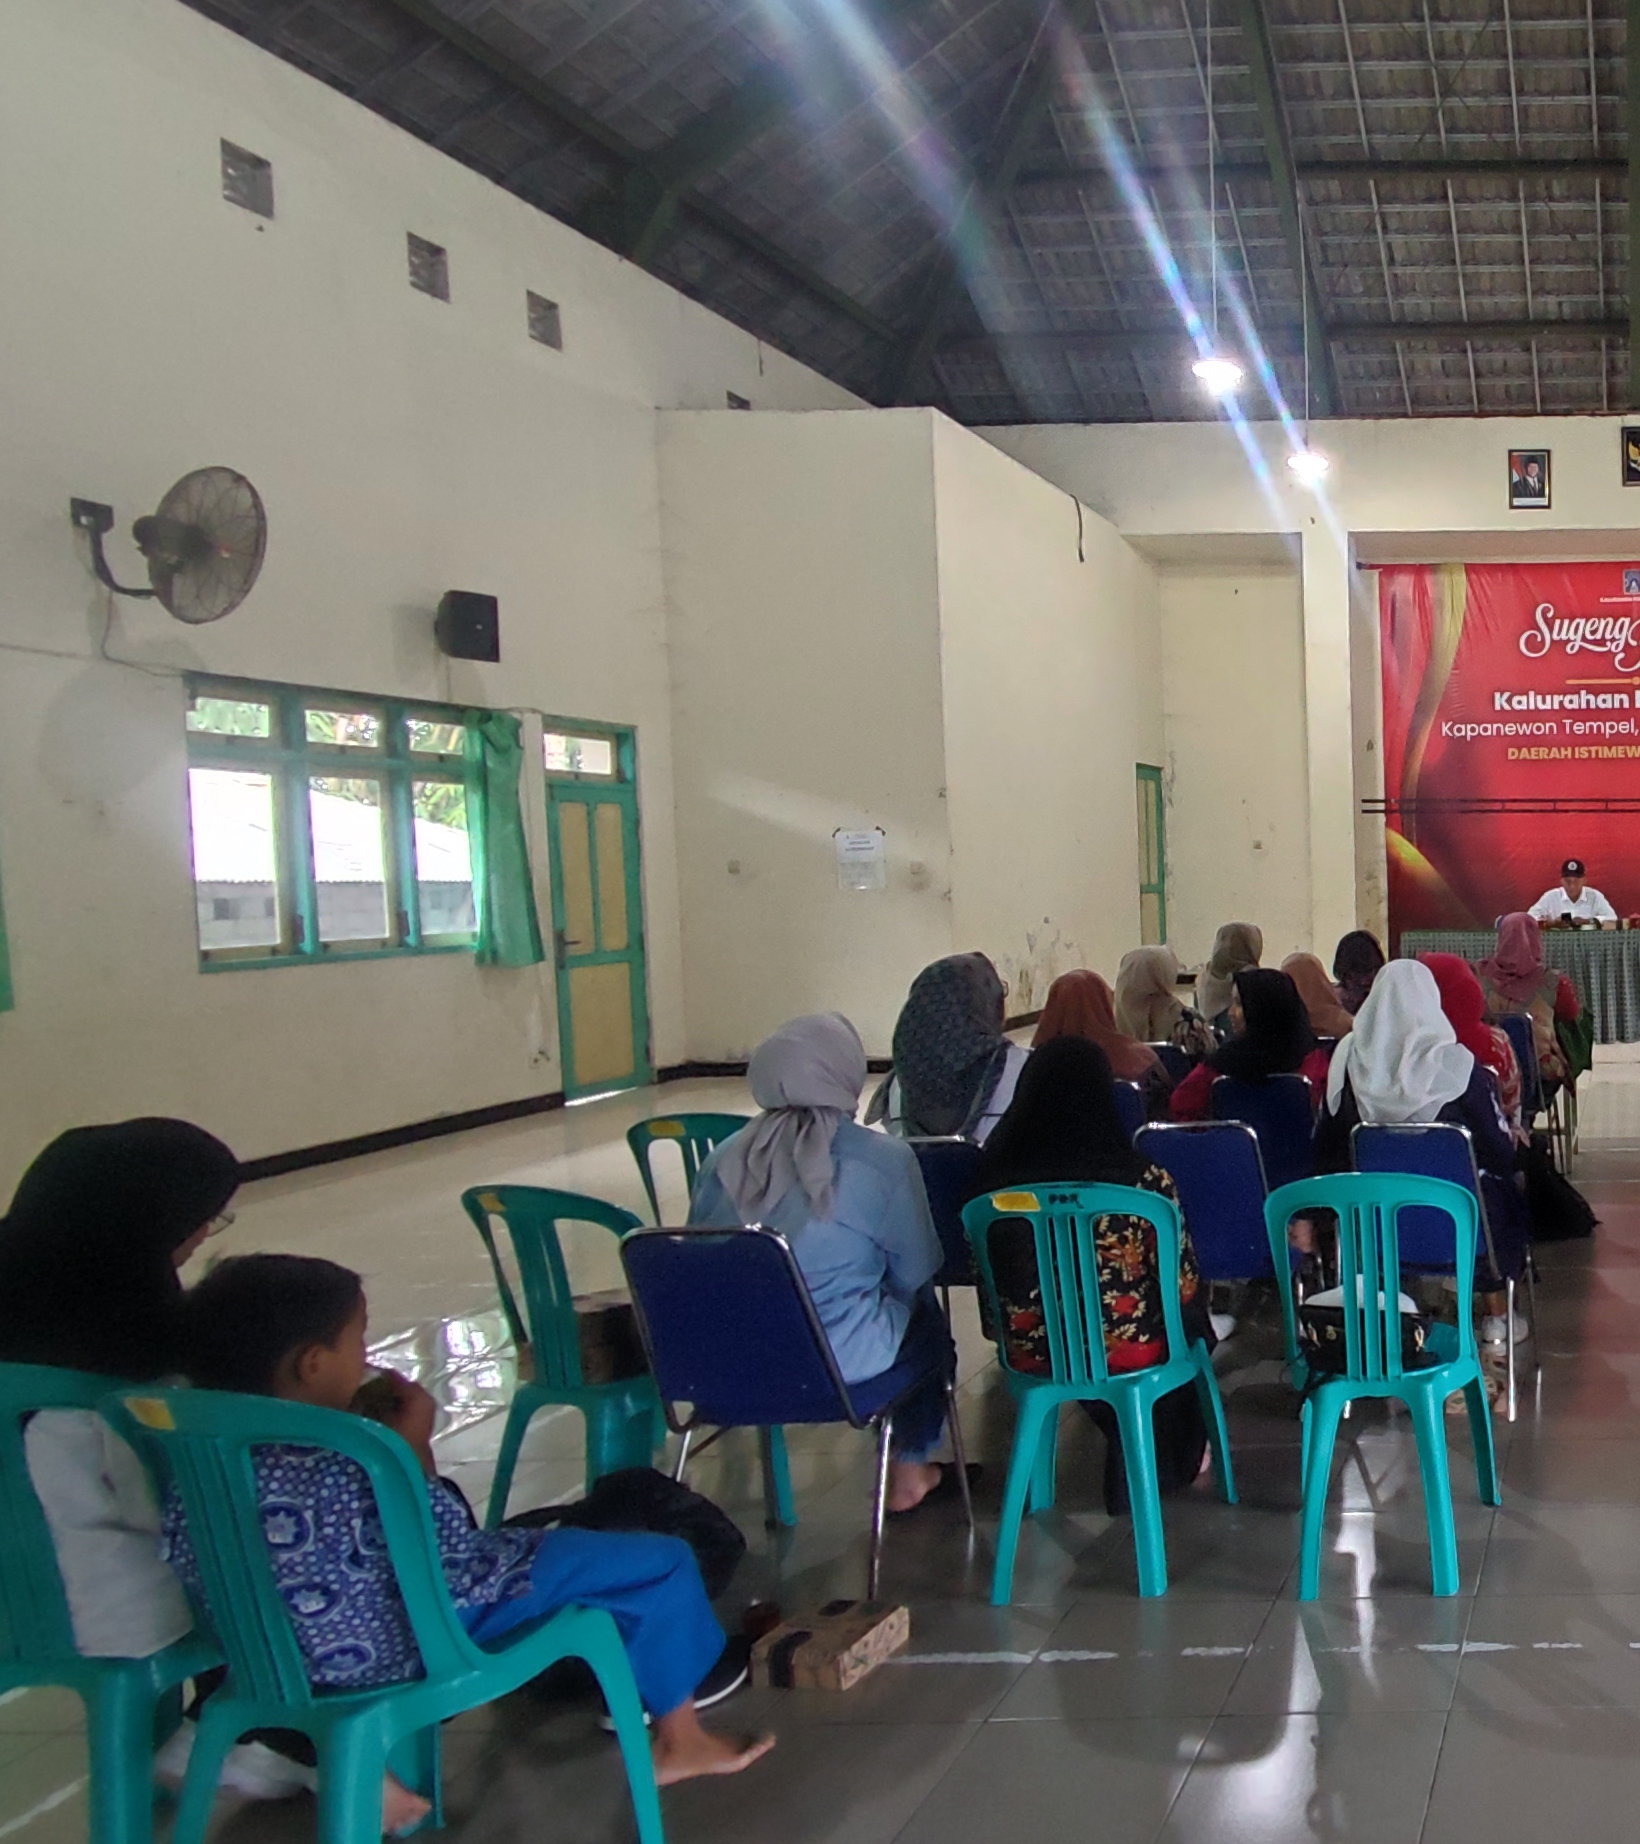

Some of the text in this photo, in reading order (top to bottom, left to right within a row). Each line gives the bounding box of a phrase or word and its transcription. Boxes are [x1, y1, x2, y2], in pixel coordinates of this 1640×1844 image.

[1519, 603, 1631, 658] Sugeng
[1494, 690, 1630, 711] Kalurahan
[1441, 721, 1558, 742] Kapanewon
[1562, 717, 1639, 739] Tempel,
[1507, 746, 1572, 760] DAERAH
